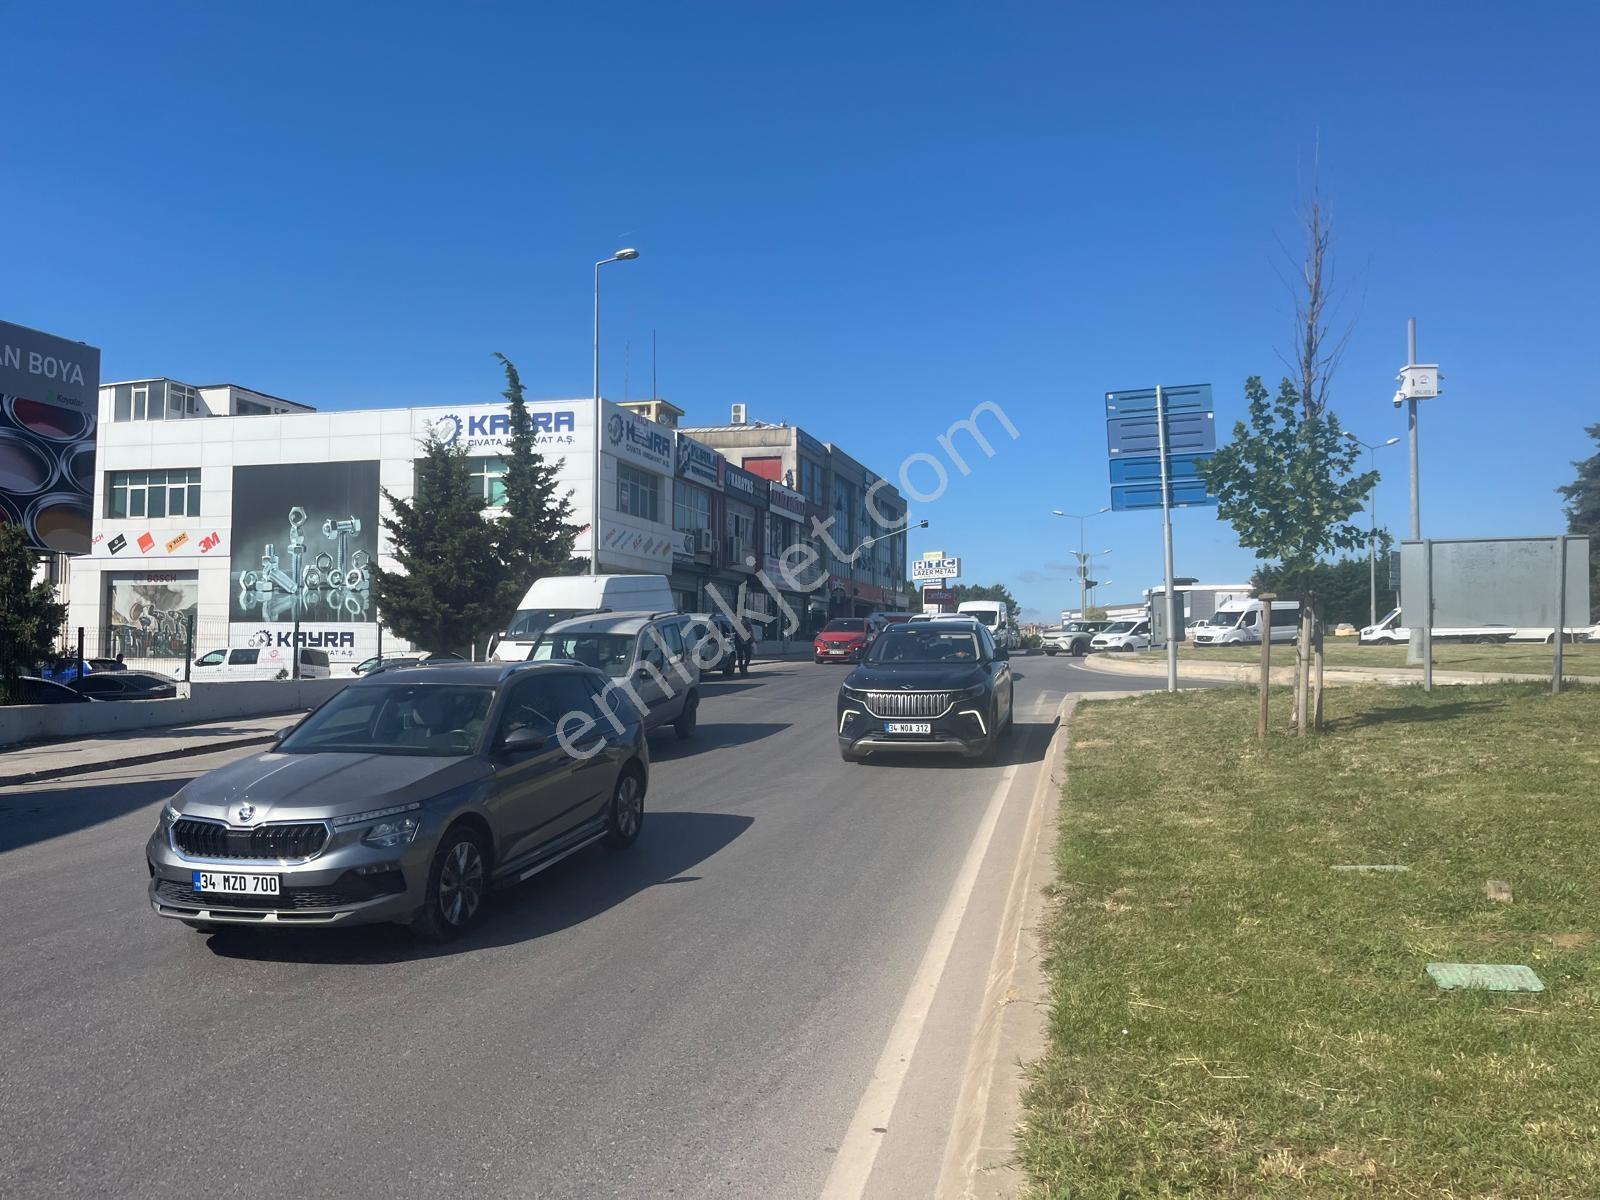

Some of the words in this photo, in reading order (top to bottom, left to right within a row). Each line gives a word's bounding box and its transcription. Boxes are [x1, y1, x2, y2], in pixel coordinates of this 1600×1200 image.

[0, 345, 20, 370] N
[29, 351, 85, 387] BOYA
[468, 411, 575, 437] KARA
[198, 531, 222, 554] 3M
[147, 574, 177, 583] BOSCH
[277, 631, 355, 648] KAYRA
[916, 724, 929, 733] 312
[201, 874, 216, 889] 34
[223, 875, 247, 891] MZD
[253, 876, 277, 892] 700
